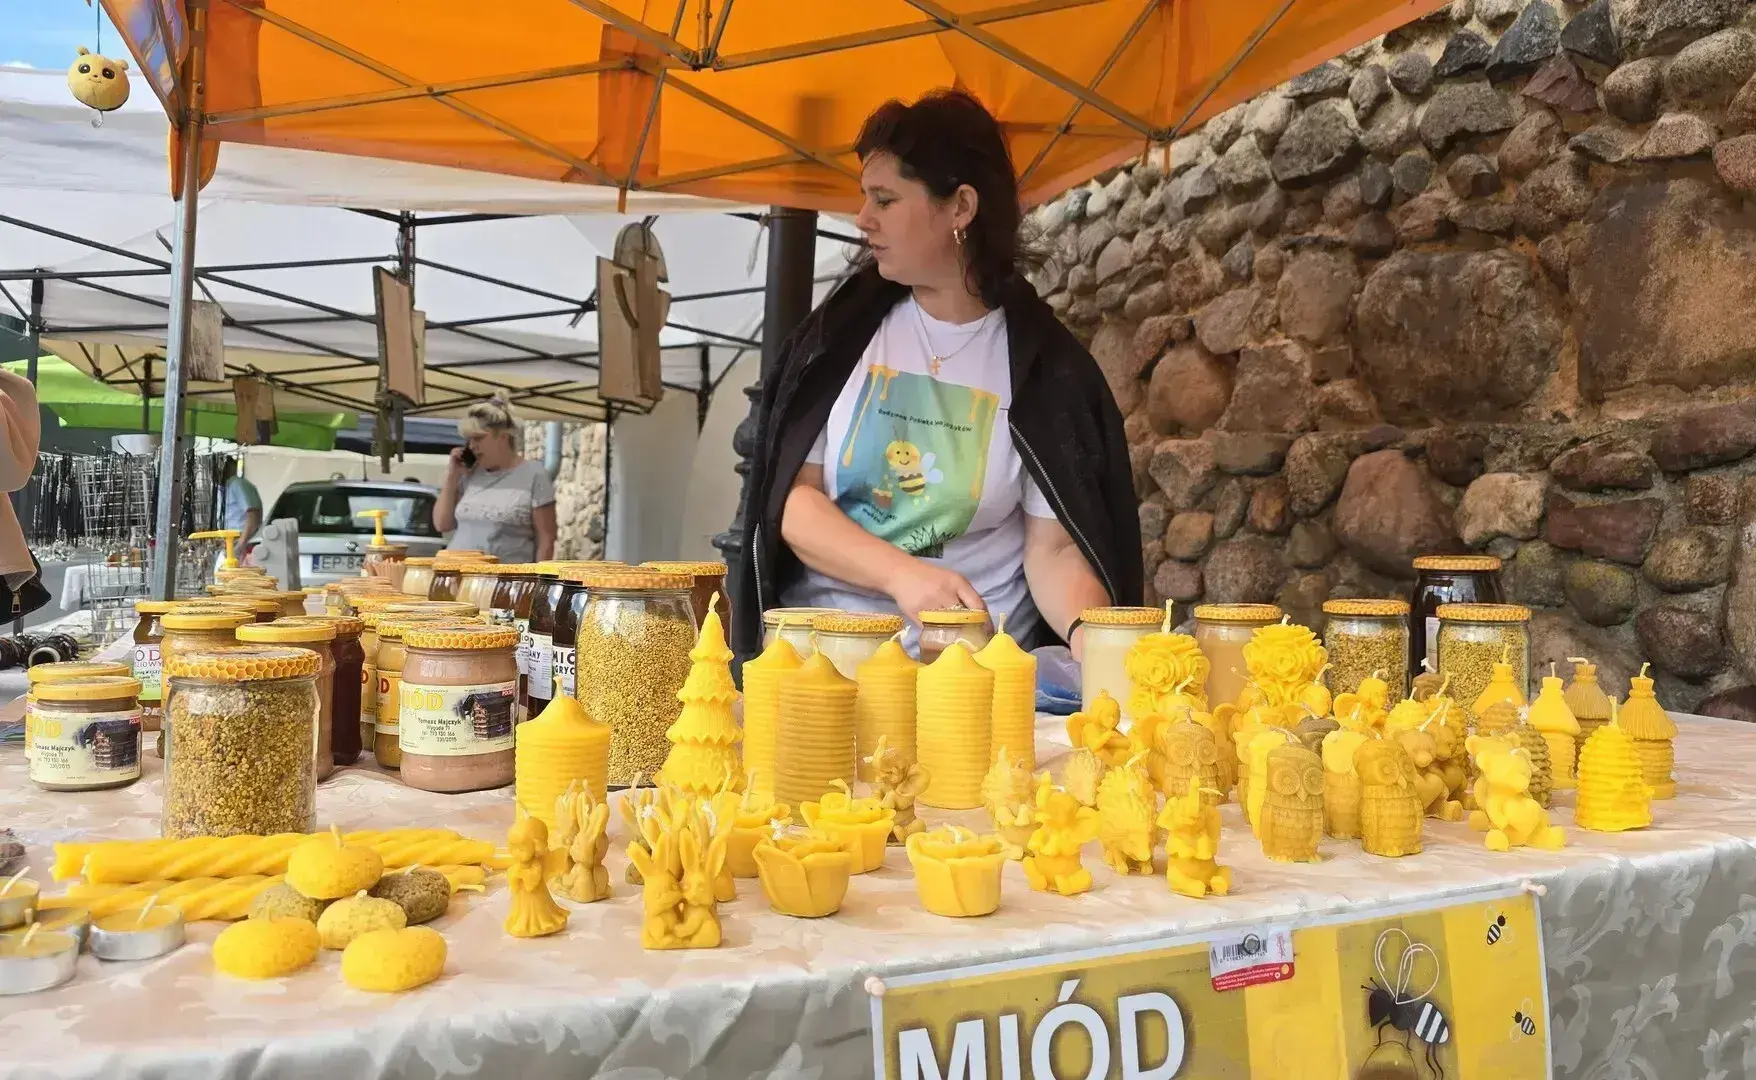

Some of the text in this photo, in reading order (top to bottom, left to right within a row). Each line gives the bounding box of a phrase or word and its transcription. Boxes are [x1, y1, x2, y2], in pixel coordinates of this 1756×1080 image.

[135, 646, 160, 662] ÓD
[553, 649, 575, 666] MIÓ
[898, 978, 1186, 1080] MIÓD
